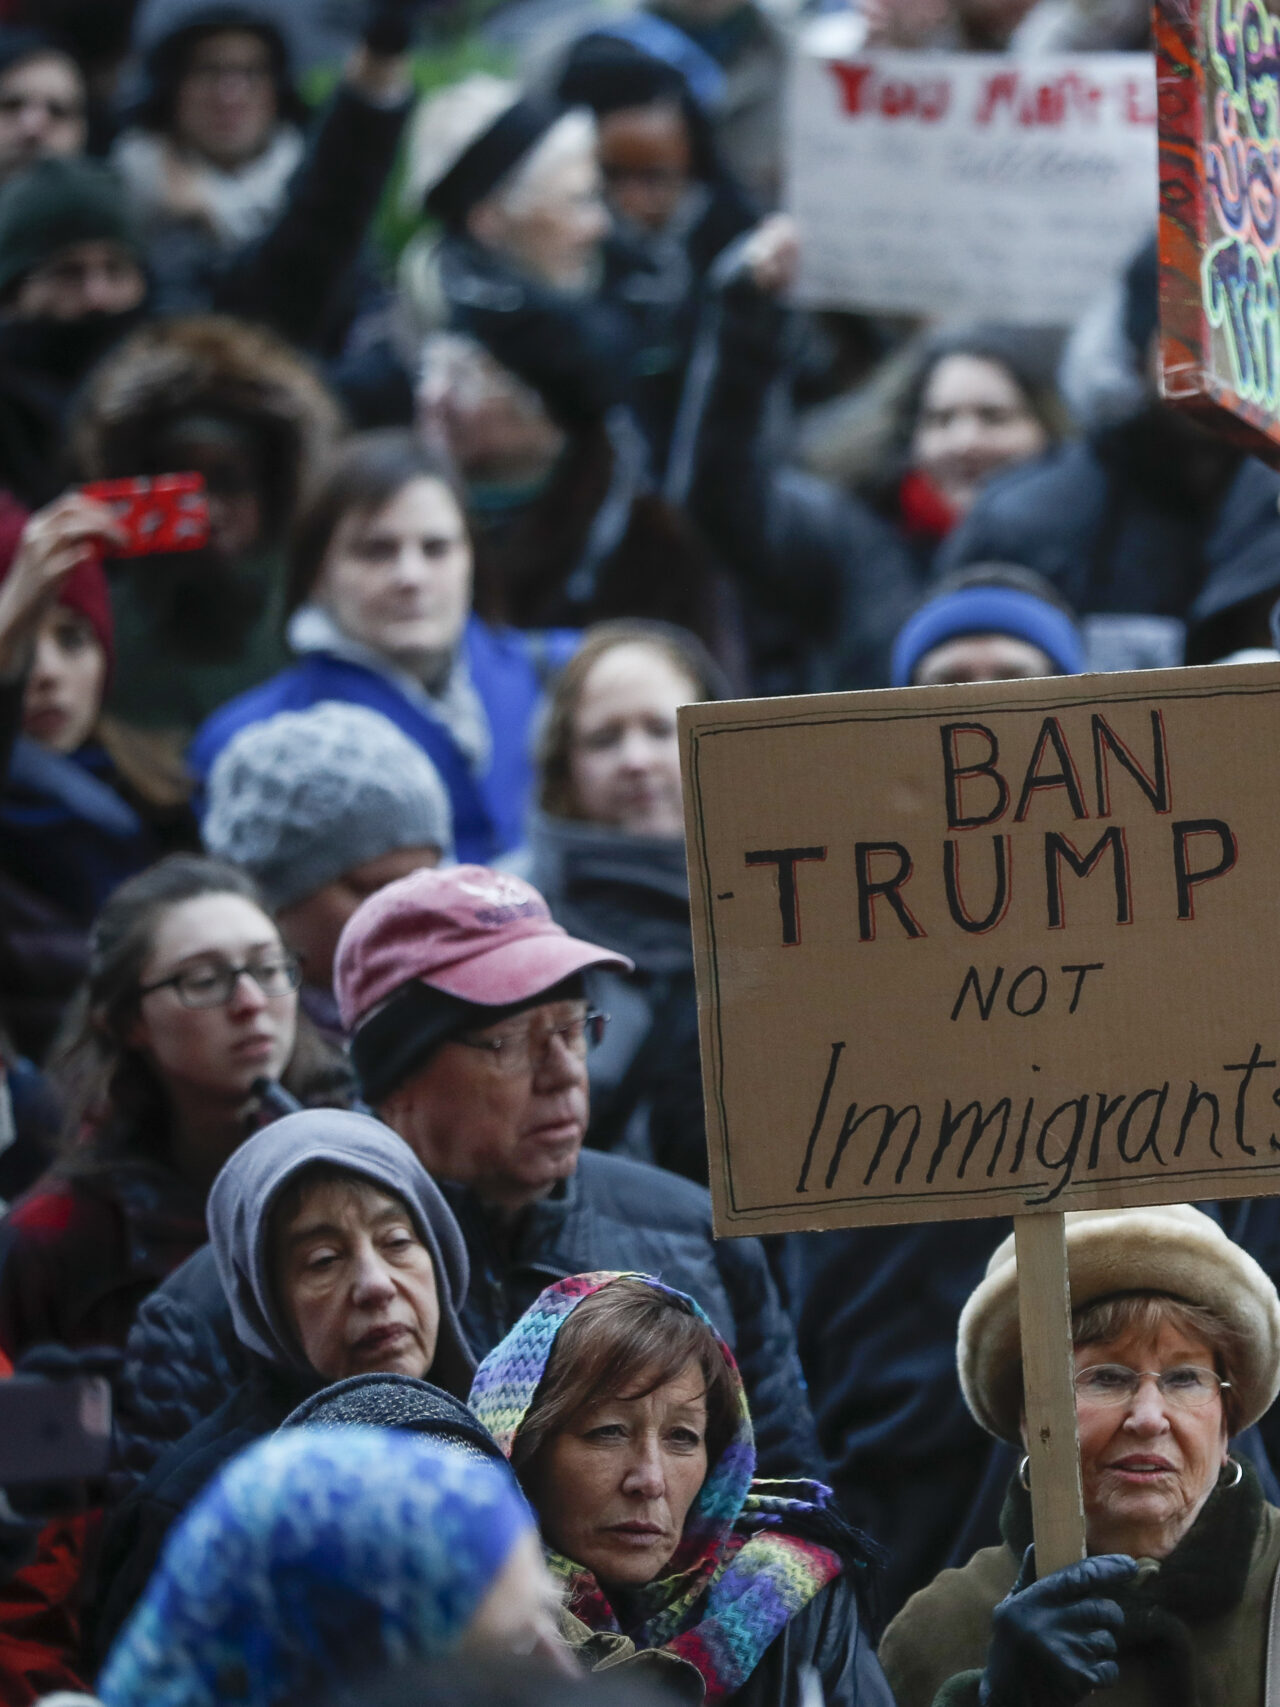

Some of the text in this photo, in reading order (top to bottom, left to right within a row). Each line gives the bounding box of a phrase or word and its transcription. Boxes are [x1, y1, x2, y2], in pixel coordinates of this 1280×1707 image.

[940, 708, 1172, 831] BAN
[745, 819, 1239, 946] TRUMP
[950, 962, 1105, 1022] NOT
